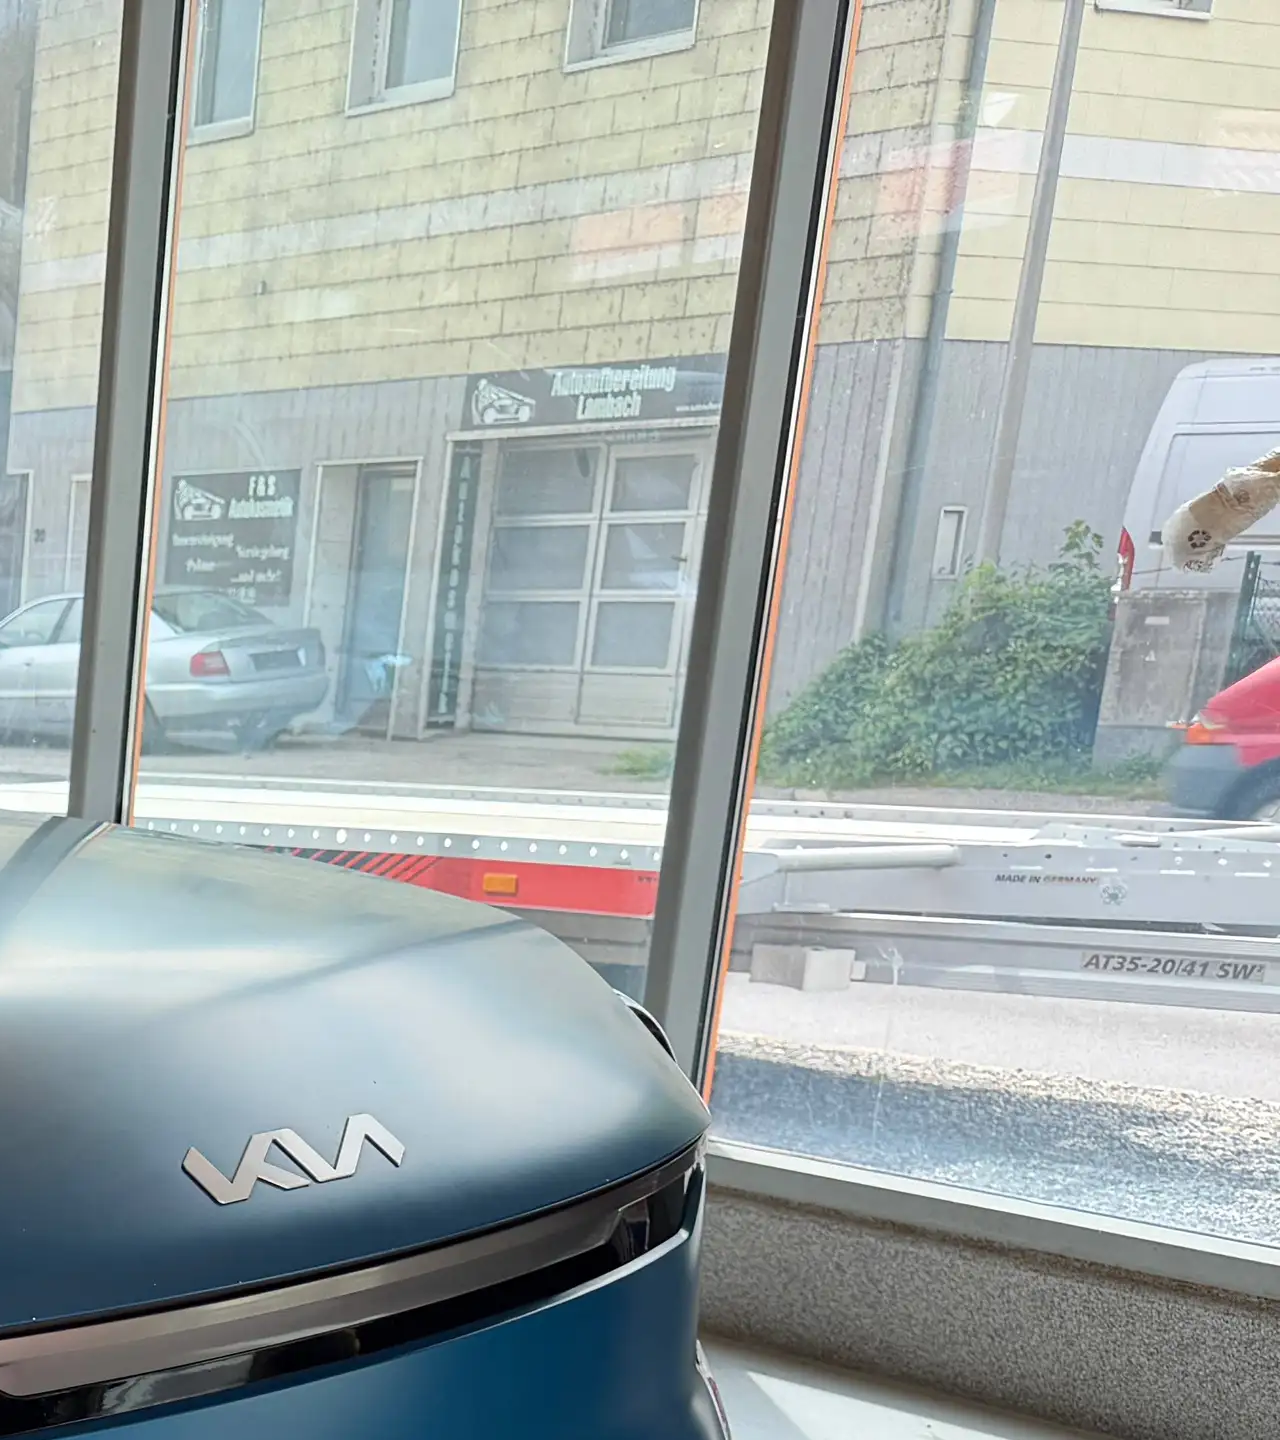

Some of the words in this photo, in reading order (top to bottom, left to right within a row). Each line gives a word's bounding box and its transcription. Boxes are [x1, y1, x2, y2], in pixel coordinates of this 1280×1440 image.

[551, 364, 676, 396] Autoaufbereitung
[576, 391, 641, 420] Lambach
[995, 874, 1031, 884] MADE
[1035, 875, 1041, 884] IN
[1083, 954, 1210, 978] AT35-20/41
[181, 1113, 406, 1206] KIA
